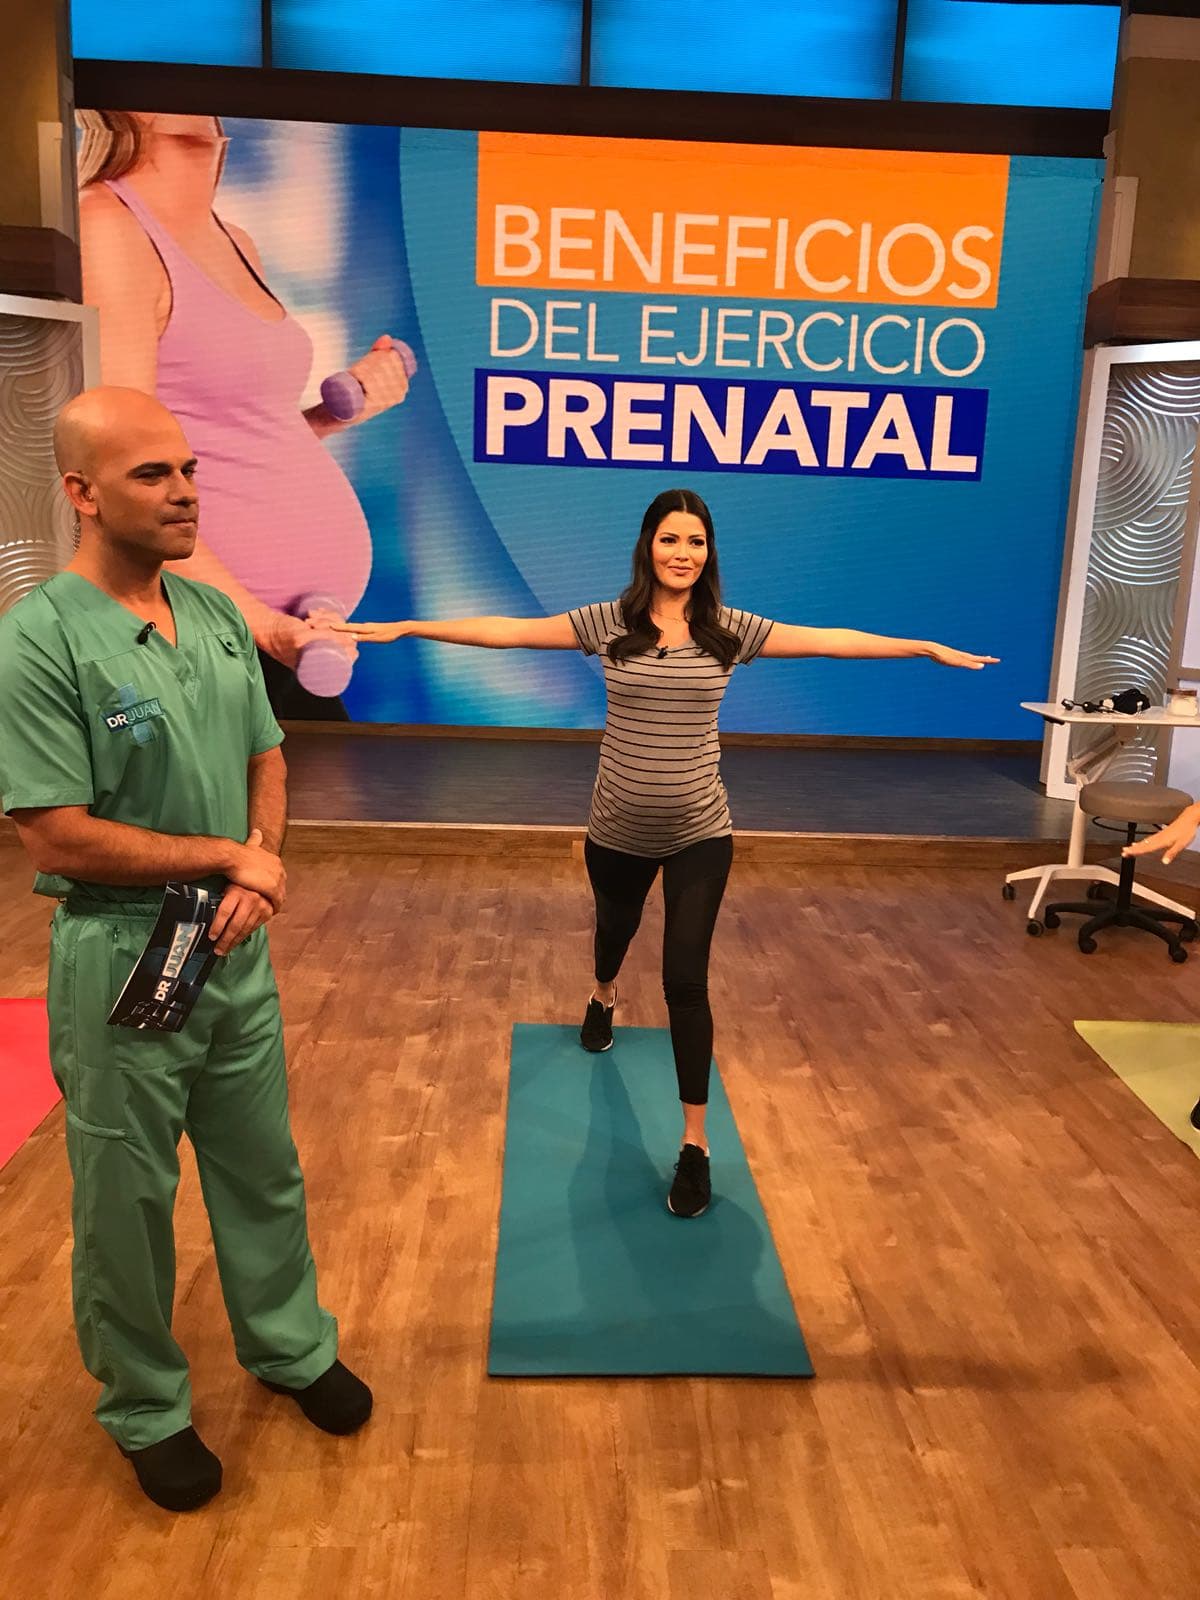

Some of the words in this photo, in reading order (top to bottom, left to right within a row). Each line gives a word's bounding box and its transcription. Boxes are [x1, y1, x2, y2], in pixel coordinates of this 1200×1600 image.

[493, 204, 994, 300] BENEFICIOS
[489, 298, 620, 363] DEL
[640, 305, 986, 378] EJERCICIO
[485, 376, 978, 473] PRENATAL
[106, 713, 129, 728] DR
[128, 699, 162, 721] JUAN
[154, 980, 172, 1001] DR
[165, 924, 196, 977] JUAN
